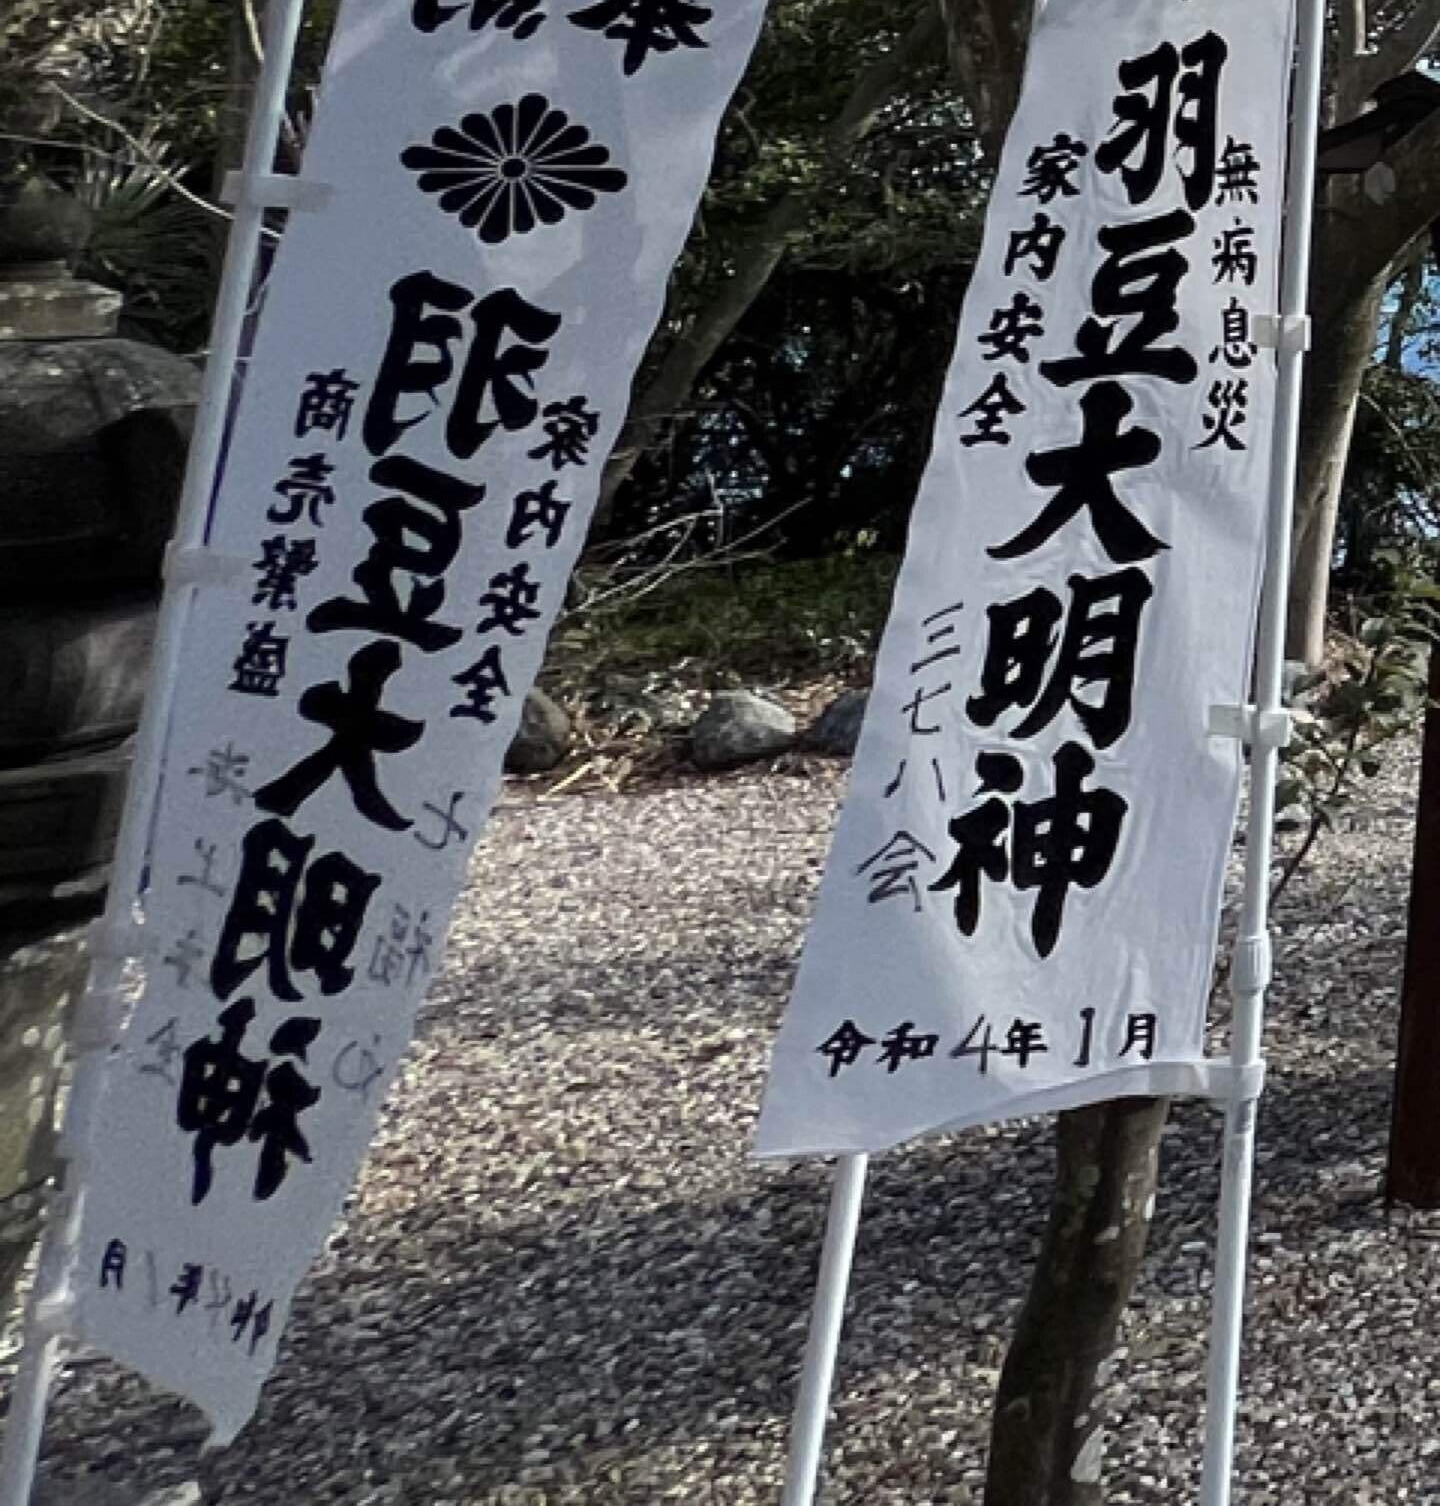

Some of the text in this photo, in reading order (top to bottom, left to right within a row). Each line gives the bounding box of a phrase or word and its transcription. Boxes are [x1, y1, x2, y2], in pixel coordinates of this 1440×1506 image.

[958, 134, 1091, 448] 家内安全
[1192, 135, 1262, 451] 無病息災
[928, 30, 1228, 959] 羽豆大明神
[856, 600, 965, 912] 三七八会
[817, 1007, 1157, 1077] 令和4年1月
